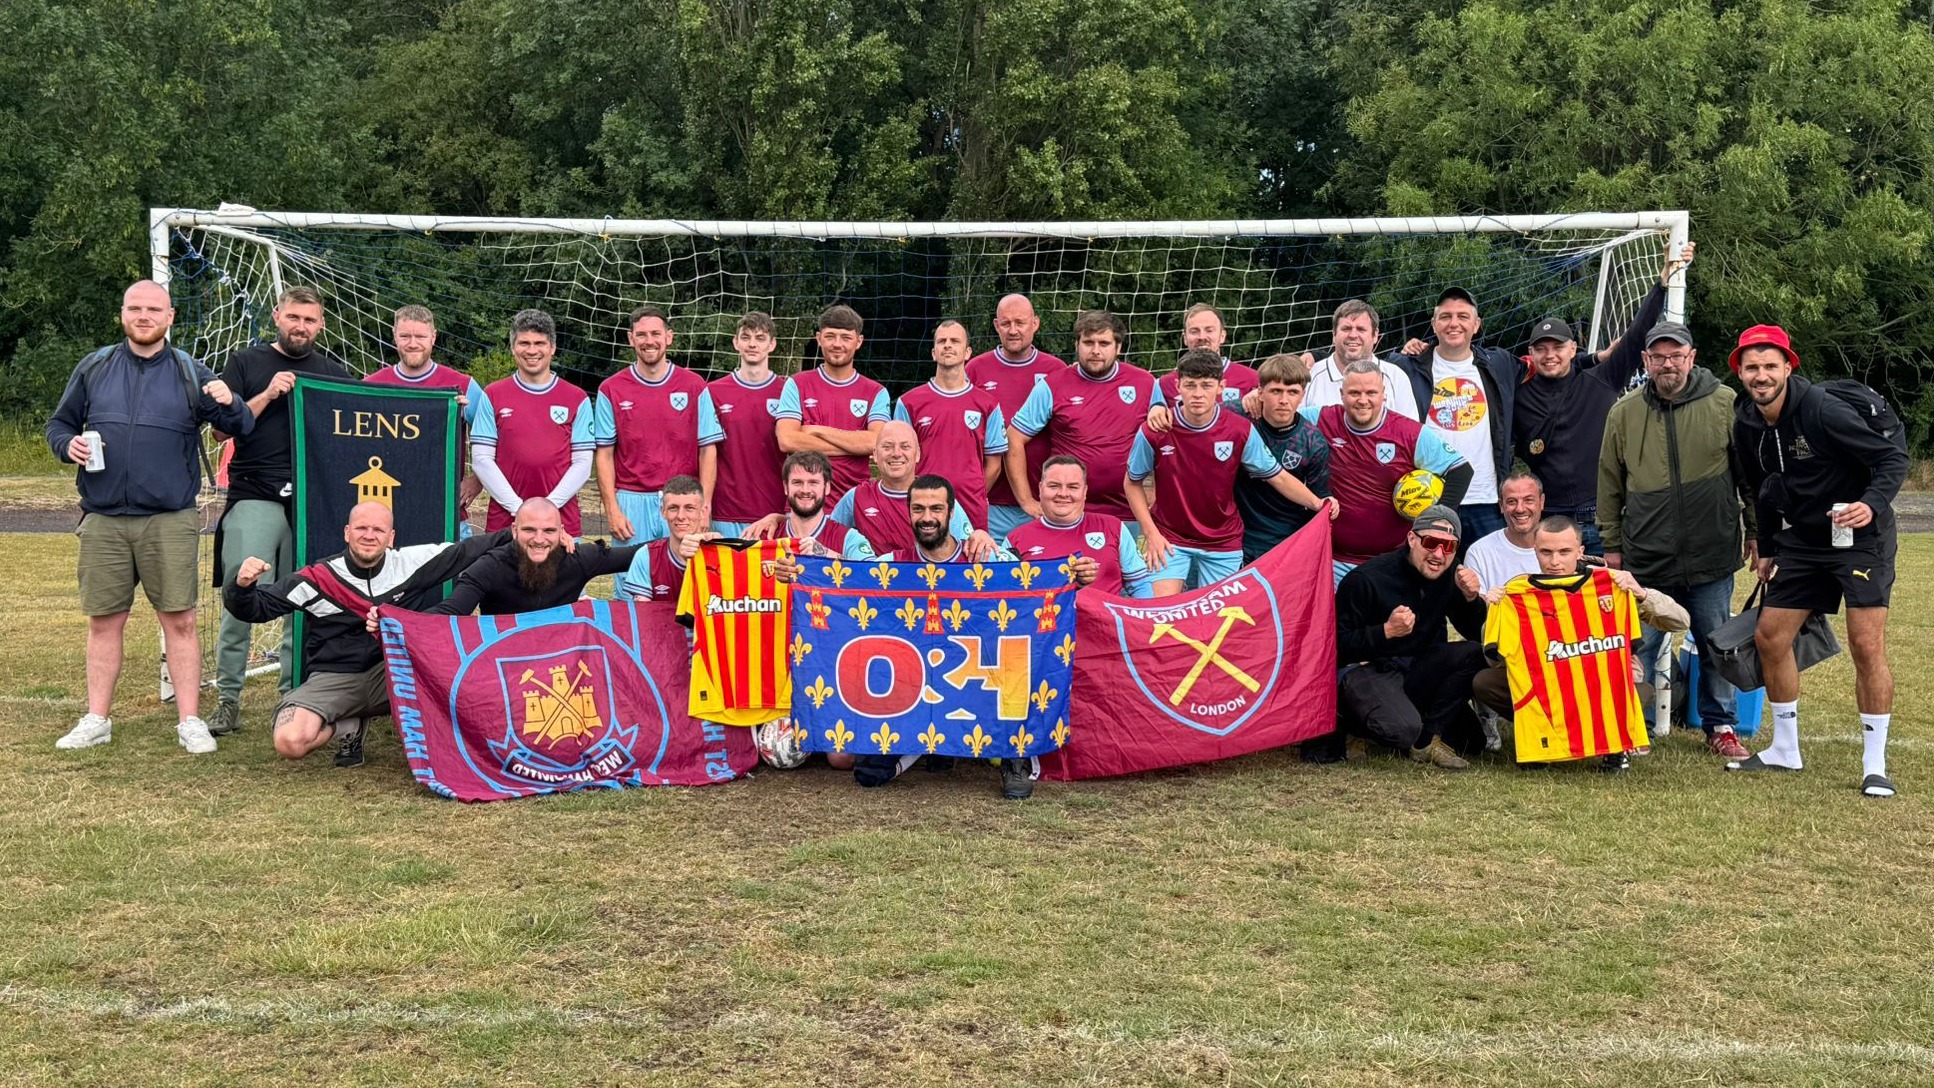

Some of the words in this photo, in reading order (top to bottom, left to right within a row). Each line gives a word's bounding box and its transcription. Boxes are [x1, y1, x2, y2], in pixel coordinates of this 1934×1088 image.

[332, 409, 421, 440] LENS
[706, 594, 782, 616] Auchan
[1546, 633, 1626, 662] Auchan
[1189, 694, 1247, 716] LONDON
